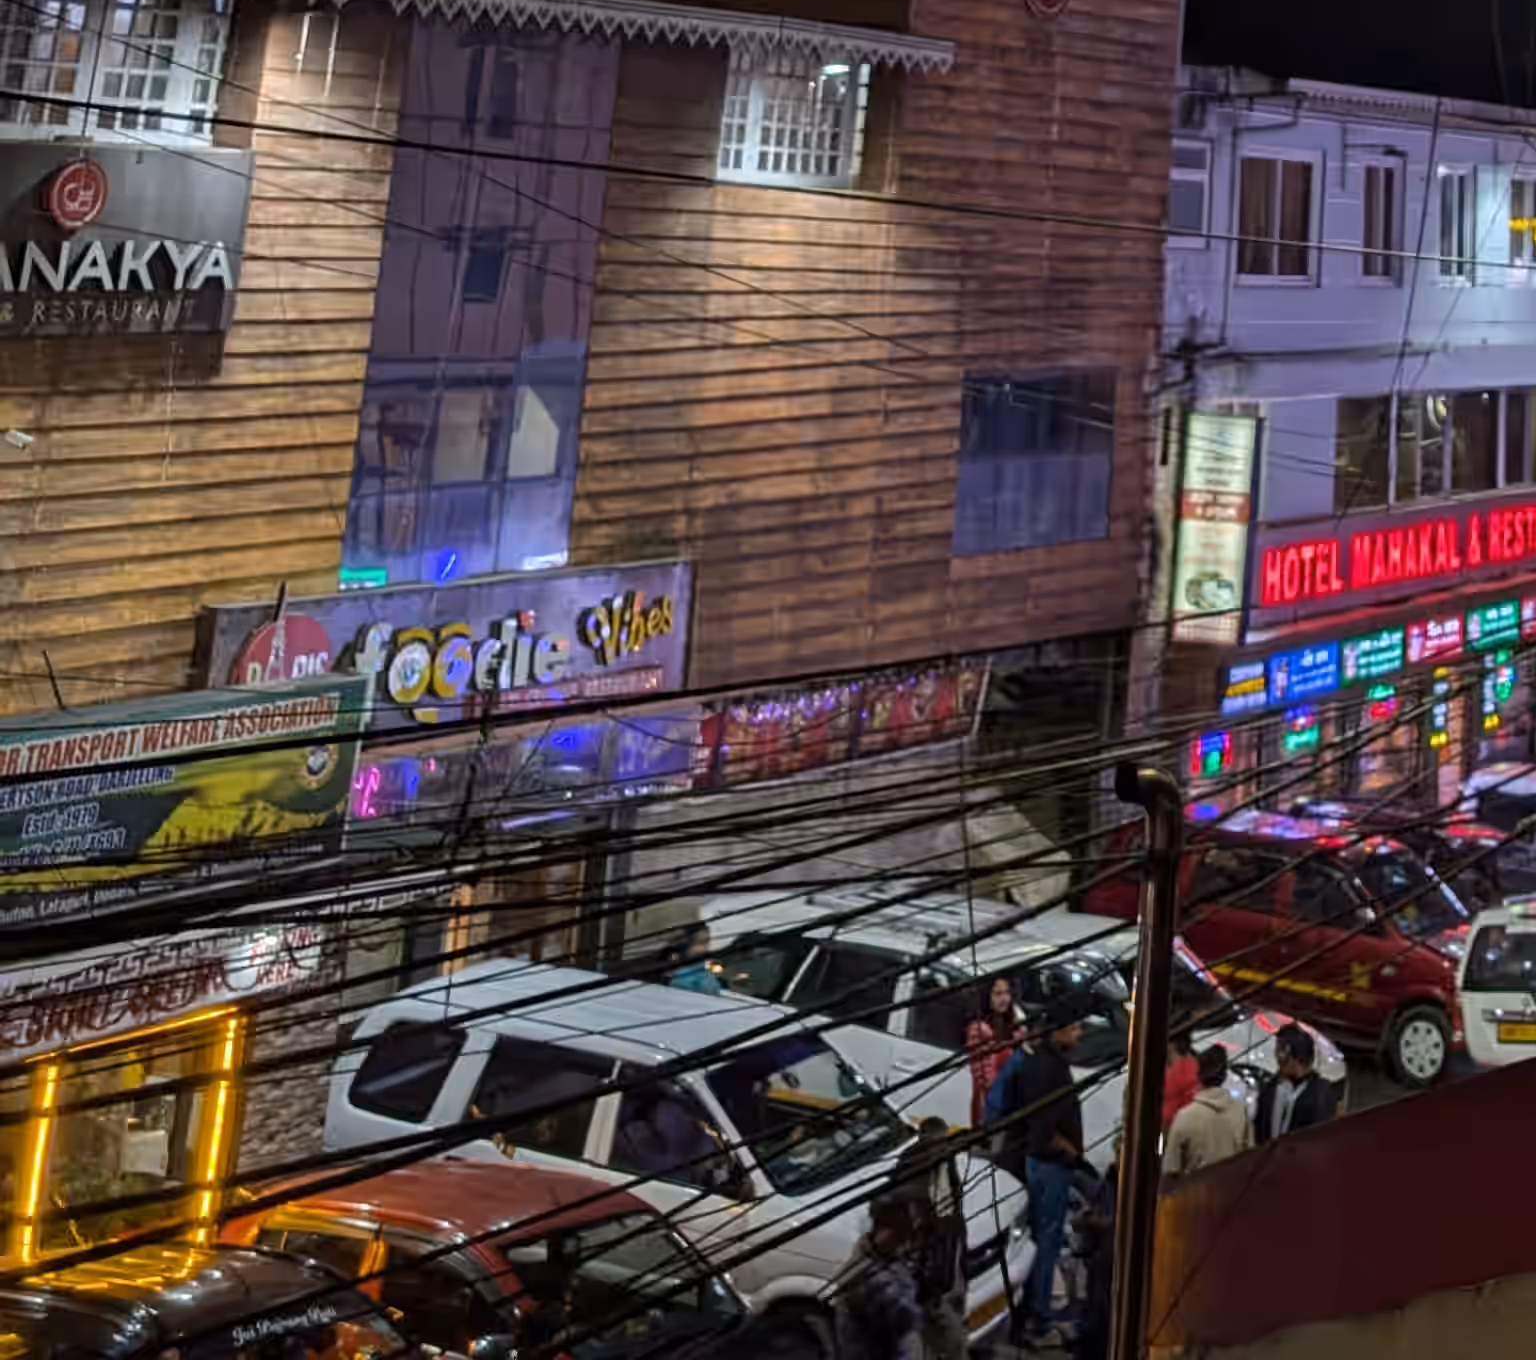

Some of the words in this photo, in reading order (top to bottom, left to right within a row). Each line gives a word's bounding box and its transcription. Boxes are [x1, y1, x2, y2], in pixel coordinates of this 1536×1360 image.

[32, 299, 196, 329] RESTAURANT
[1263, 540, 1344, 605] HOTEL
[1351, 519, 1460, 589] MAHAKAL
[1467, 514, 1482, 564] &
[26, 729, 143, 771] TRANSPORT
[142, 720, 220, 754] WELFARE
[223, 693, 340, 738] ASSOCIATION
